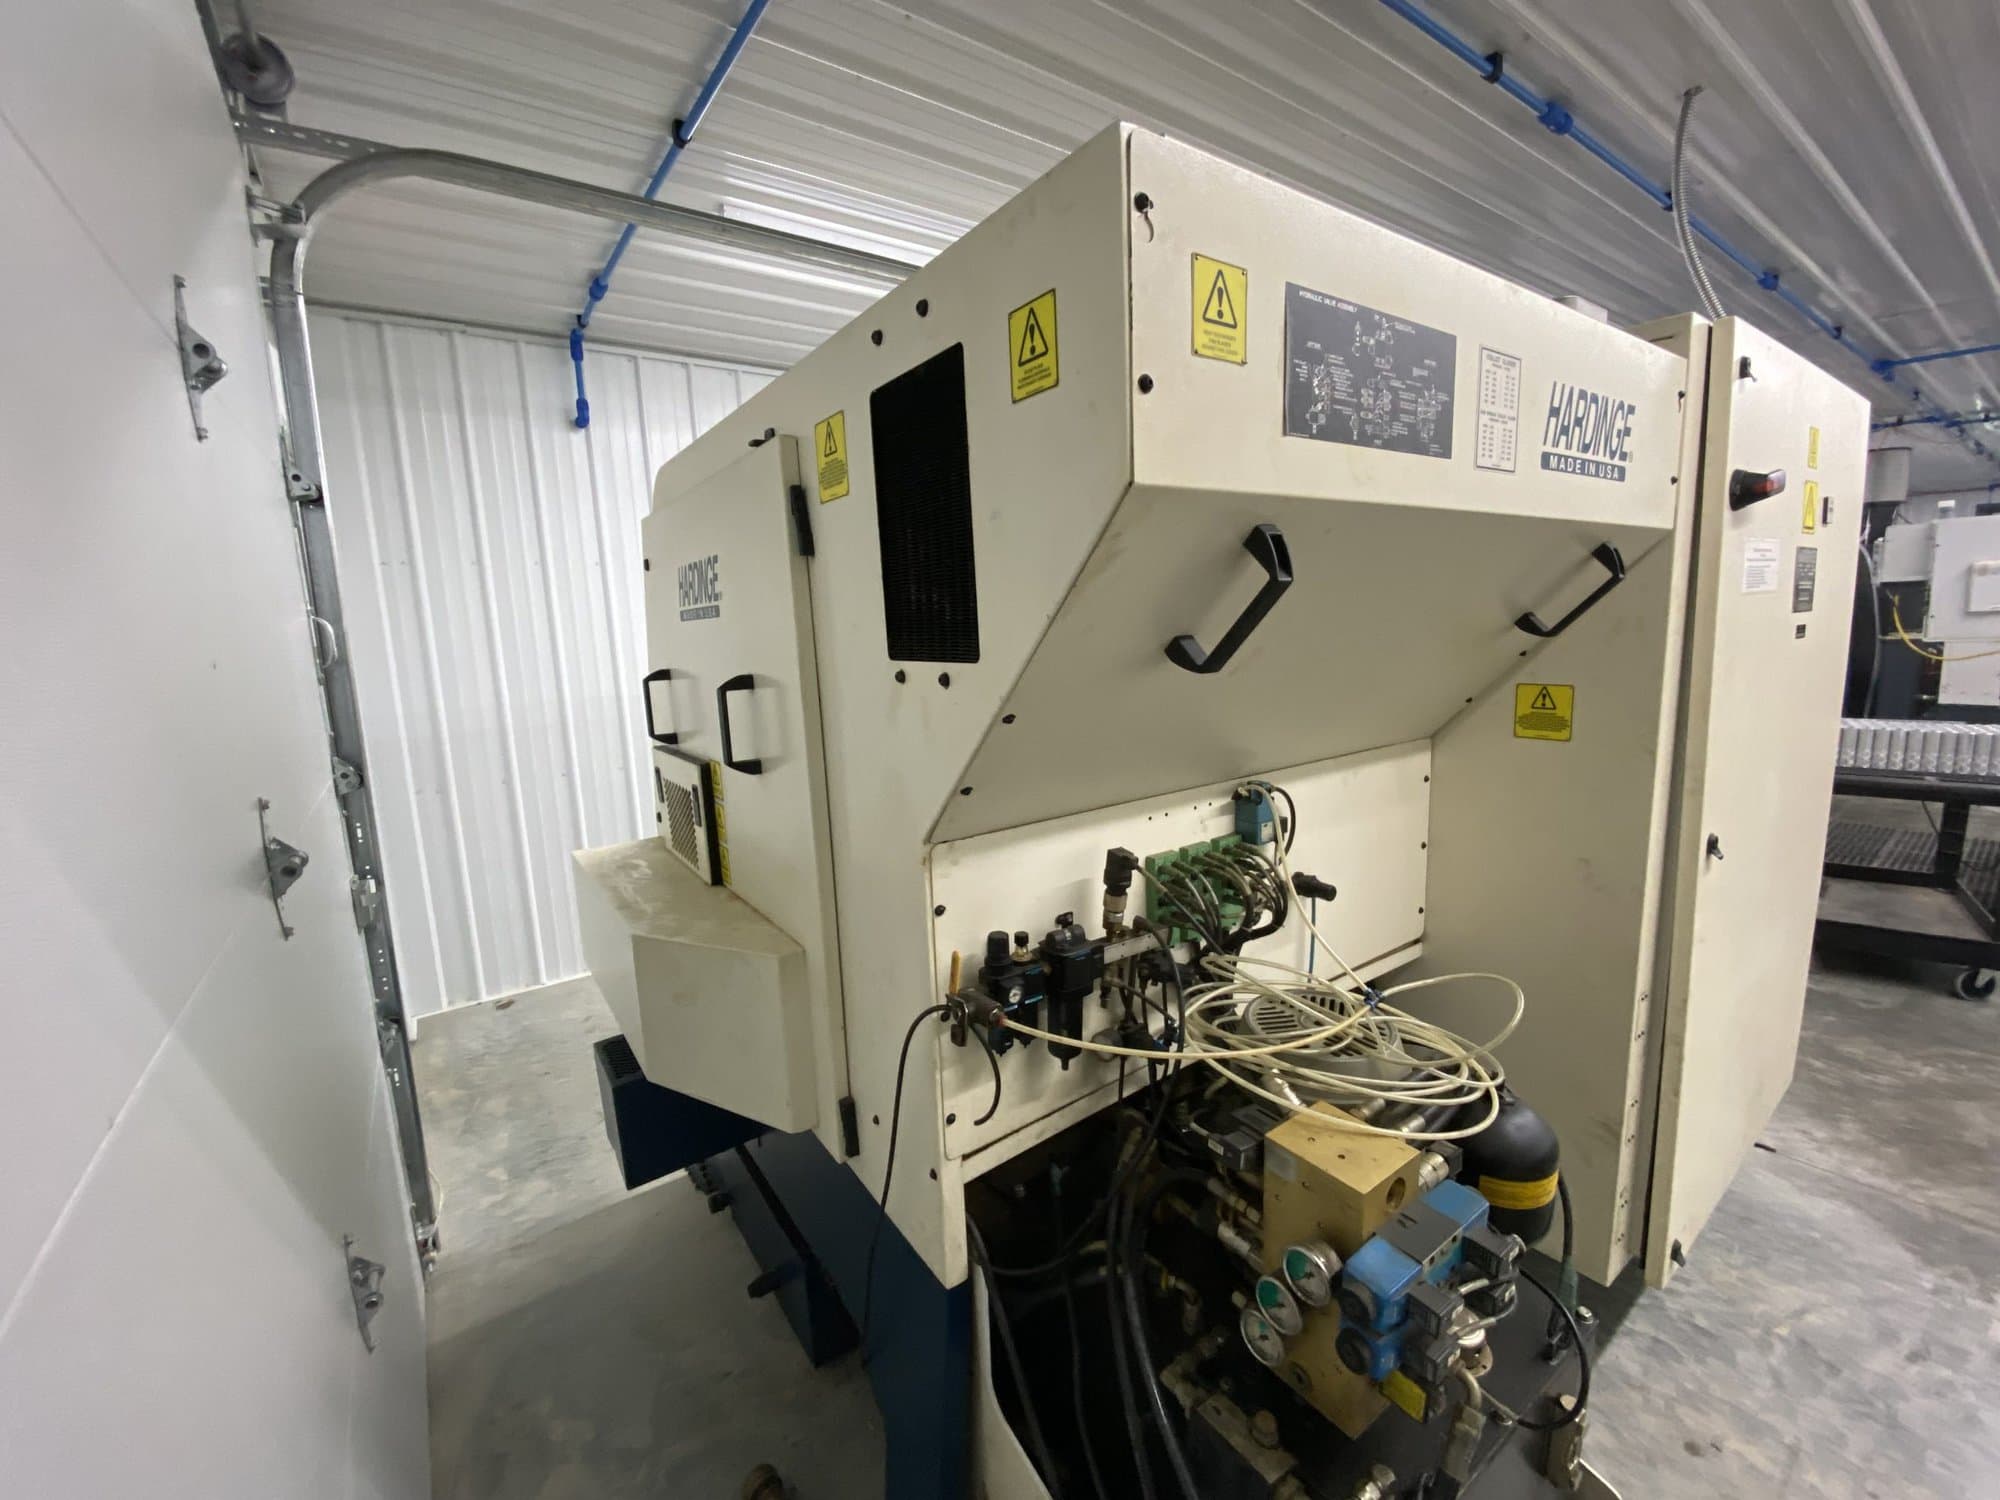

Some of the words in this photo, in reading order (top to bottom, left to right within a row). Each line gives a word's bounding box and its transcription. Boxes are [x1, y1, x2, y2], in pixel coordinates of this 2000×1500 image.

[1543, 380, 1636, 461] HARDINGE
[1549, 455, 1581, 473] MADE
[1584, 461, 1596, 475] IN
[1598, 463, 1619, 479] USA
[678, 554, 719, 608] HARDINGE
